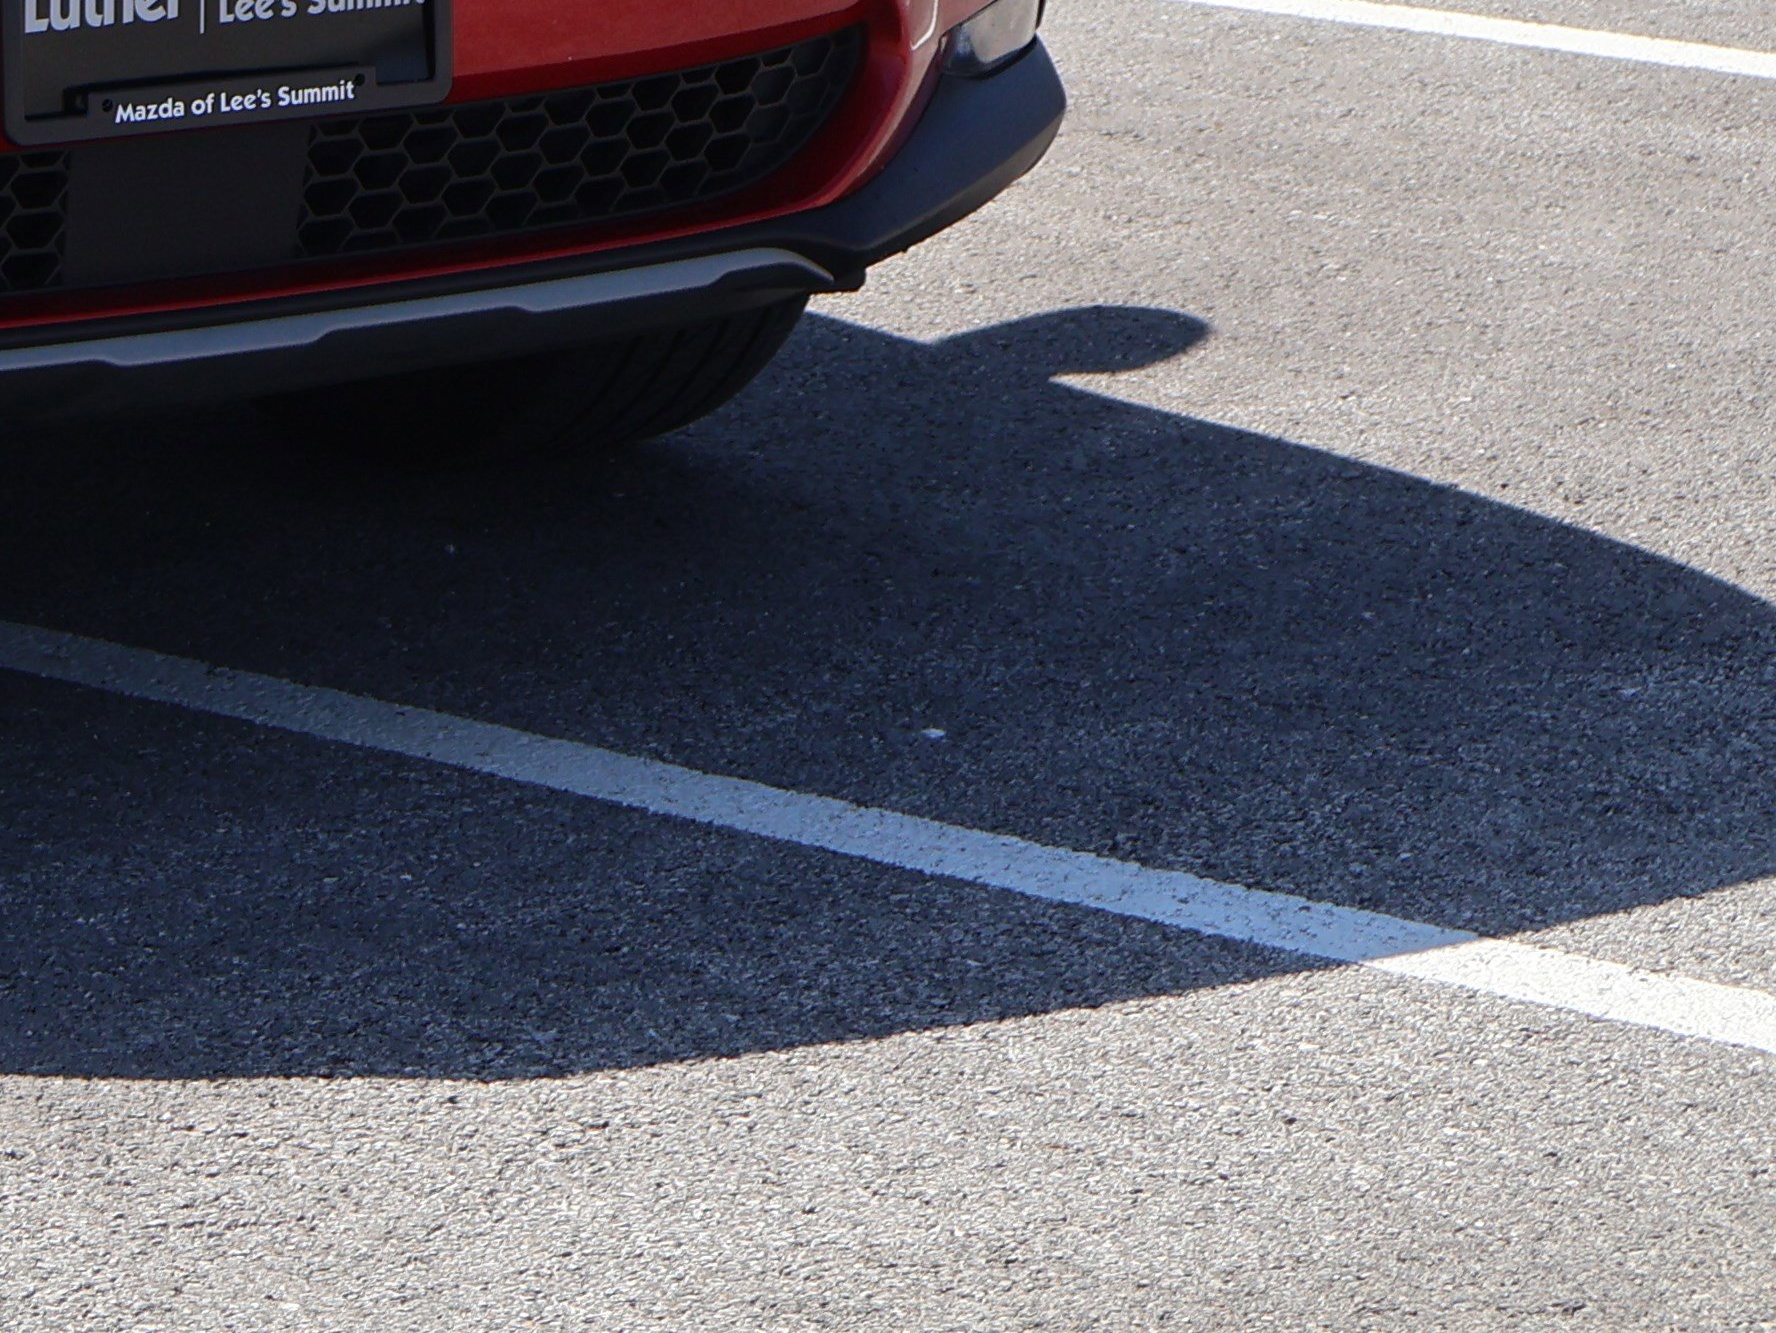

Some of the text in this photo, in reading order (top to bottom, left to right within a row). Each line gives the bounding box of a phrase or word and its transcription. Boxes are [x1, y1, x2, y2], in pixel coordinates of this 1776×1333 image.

[114, 79, 356, 124] Mazda of Lee's Summit
